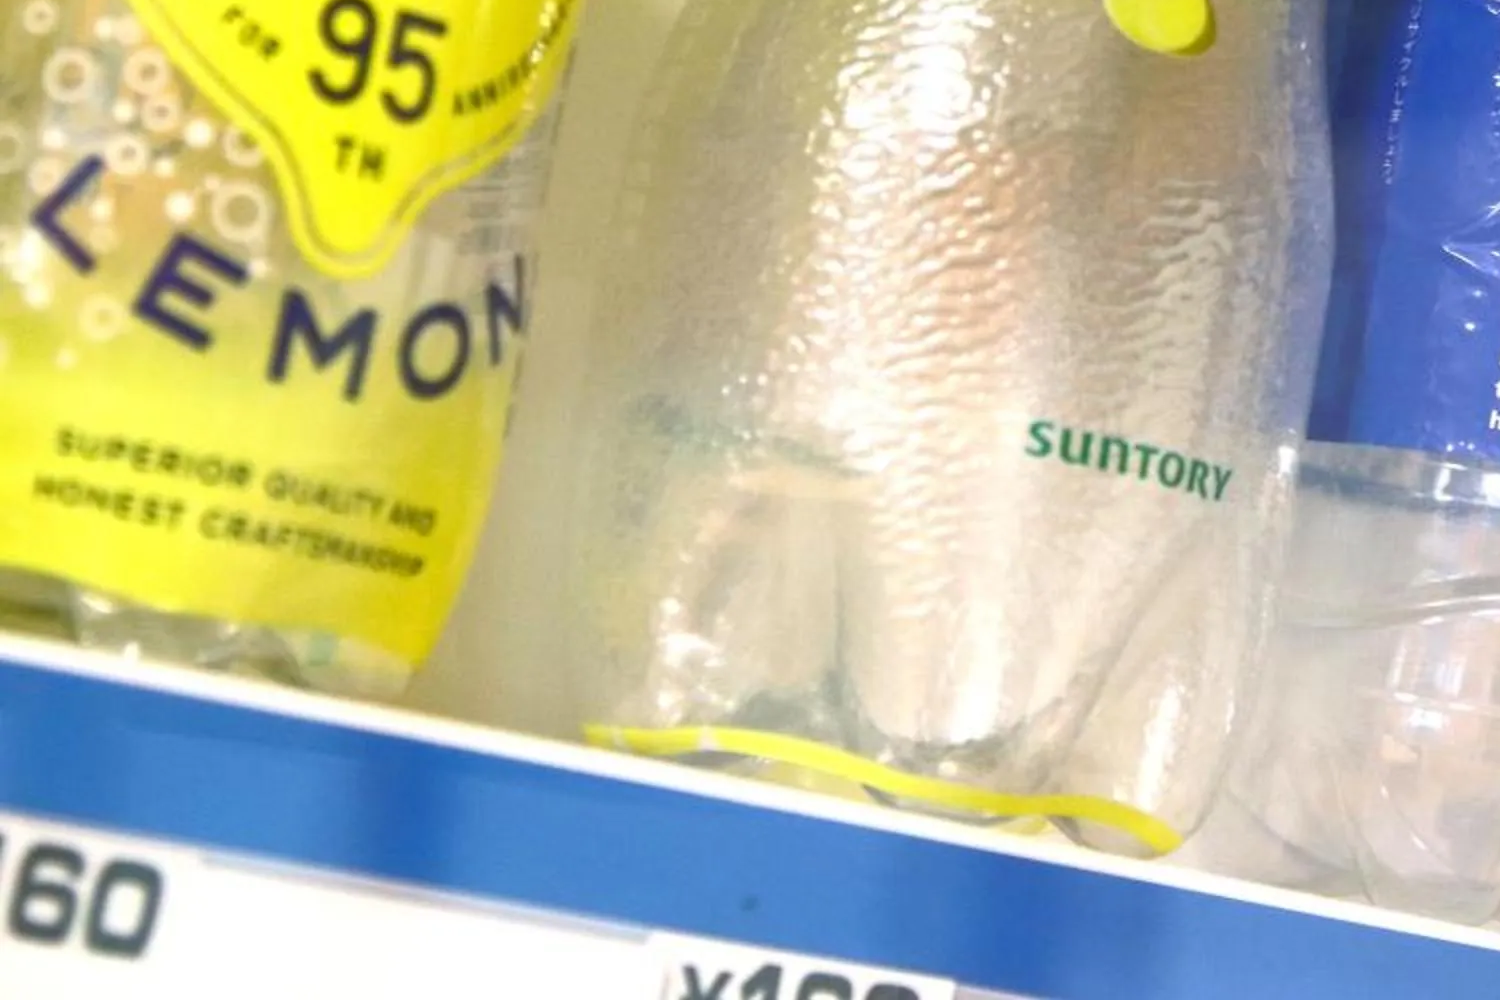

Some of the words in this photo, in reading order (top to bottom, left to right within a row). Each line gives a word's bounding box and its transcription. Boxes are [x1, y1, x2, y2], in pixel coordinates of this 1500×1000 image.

[334, 134, 389, 183] TH
[29, 154, 528, 404] LEMON
[33, 472, 186, 530] HONEST
[56, 424, 254, 490] SUPERIOR
[262, 467, 386, 522] QUALITY
[388, 498, 440, 538] AND
[1024, 419, 1234, 503] SUNTORY
[0, 840, 166, 960] 60
